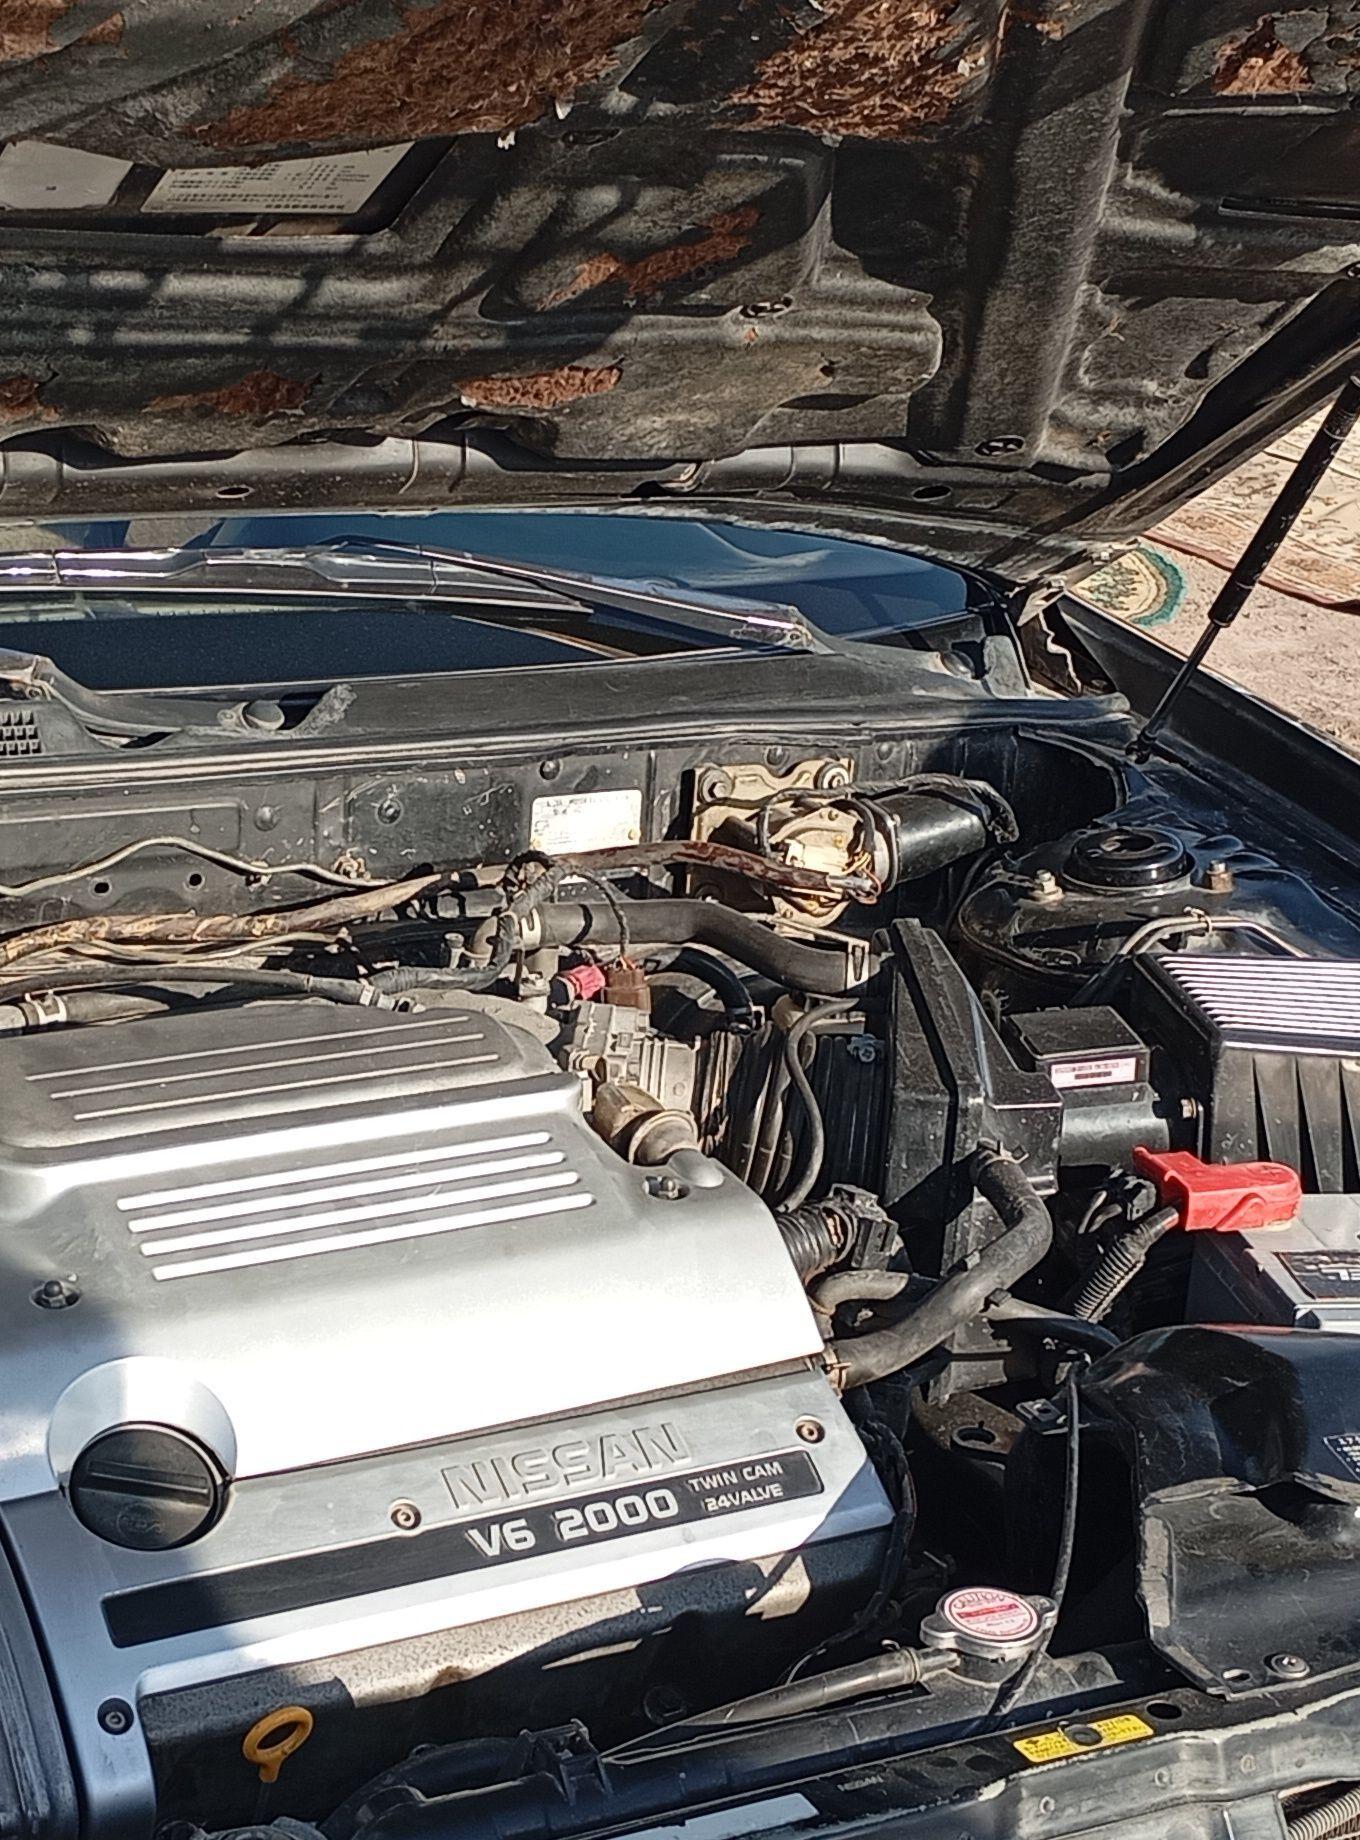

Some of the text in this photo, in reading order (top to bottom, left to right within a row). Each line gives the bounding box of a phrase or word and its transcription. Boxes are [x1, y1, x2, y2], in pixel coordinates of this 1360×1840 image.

[440, 1422, 691, 1511] NISSAN
[689, 1461, 784, 1494] TWIN CAM
[463, 1488, 680, 1557] V6 2000
[703, 1484, 784, 1512] 24VALVE
